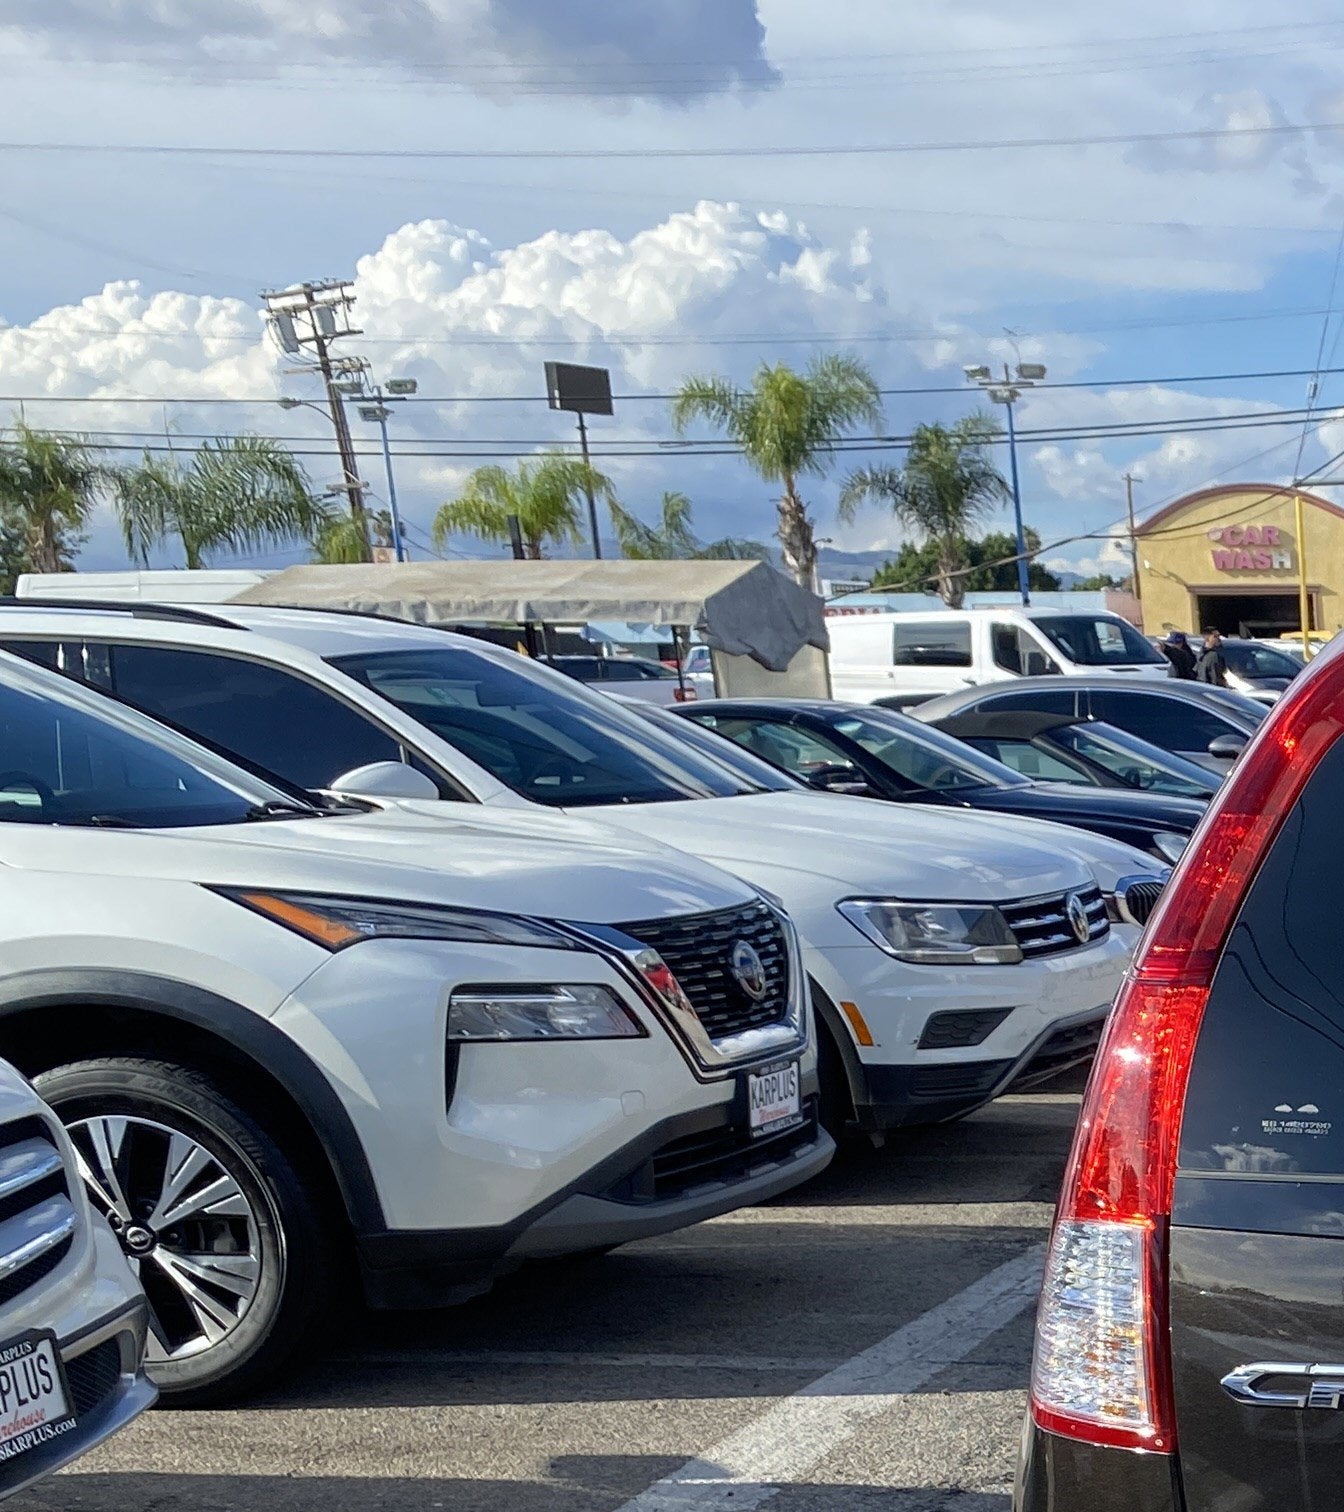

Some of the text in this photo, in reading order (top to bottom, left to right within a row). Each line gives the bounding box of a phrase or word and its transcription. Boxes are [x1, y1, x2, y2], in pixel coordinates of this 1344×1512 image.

[1222, 525, 1280, 546] CAR
[1211, 548, 1291, 570] WASH
[751, 1070, 795, 1110] KARPLUS
